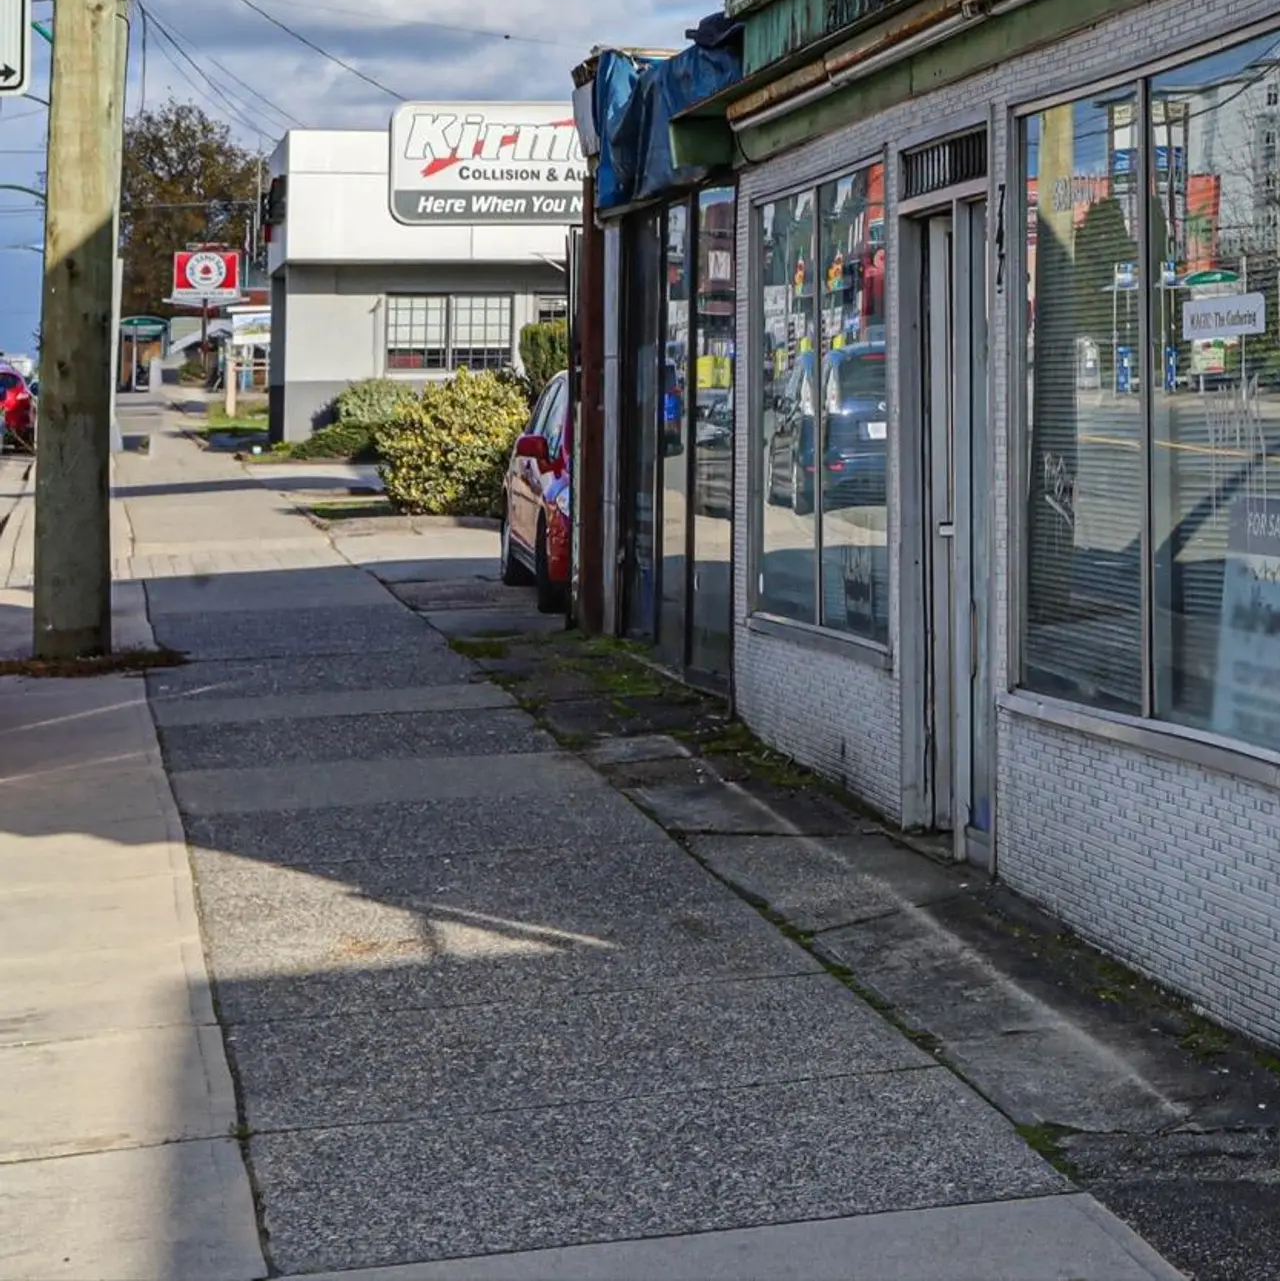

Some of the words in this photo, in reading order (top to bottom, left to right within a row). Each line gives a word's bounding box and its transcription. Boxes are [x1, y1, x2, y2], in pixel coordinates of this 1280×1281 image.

[546, 167, 558, 182] &
[417, 196, 466, 213] Here
[471, 196, 526, 213] When
[531, 196, 567, 213] You
[1247, 513, 1267, 537] FOR
